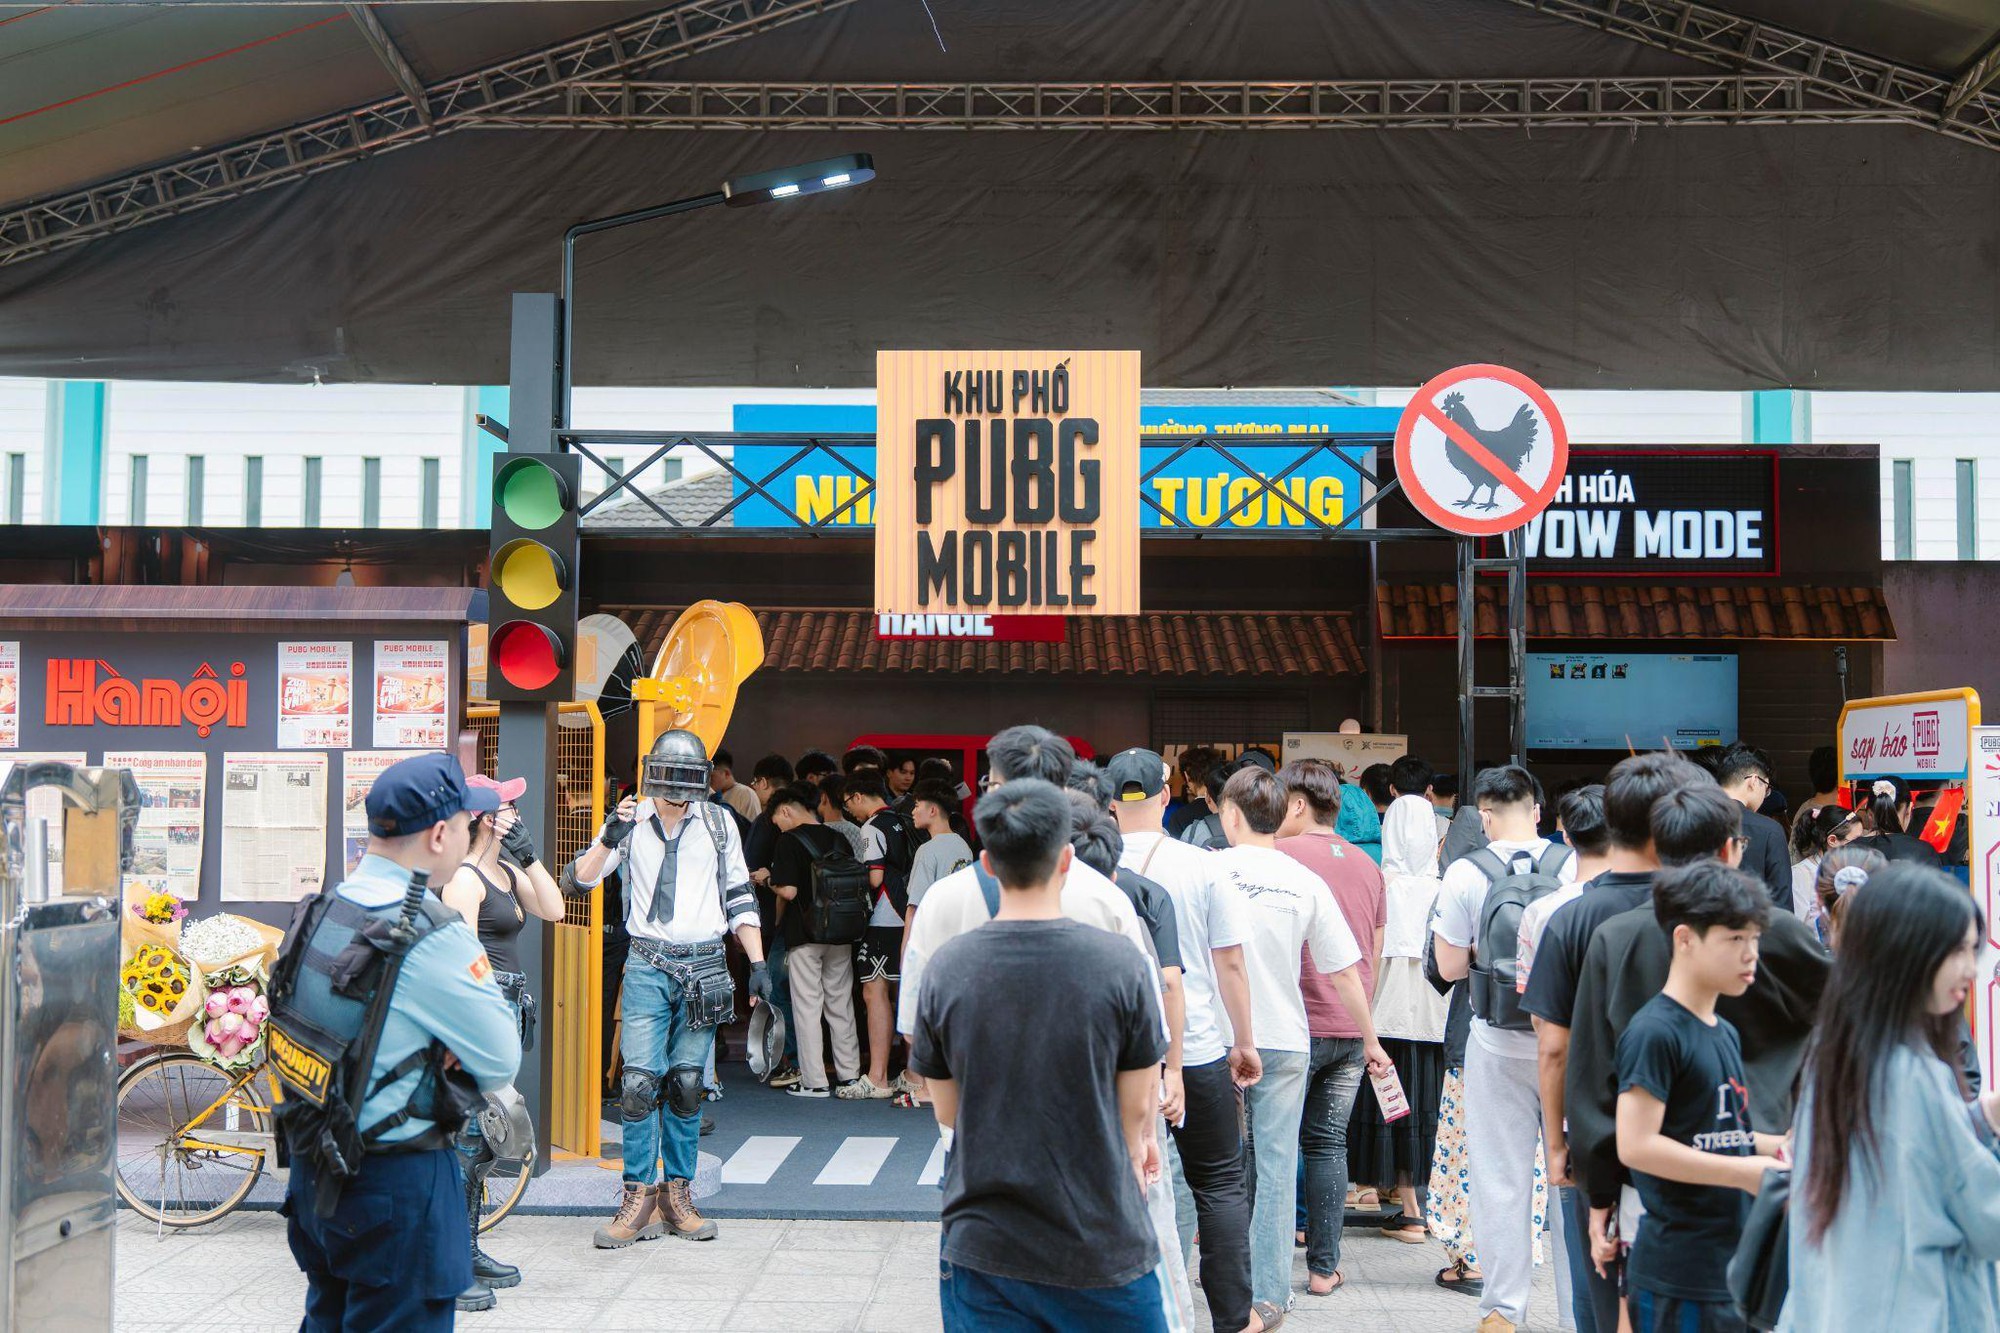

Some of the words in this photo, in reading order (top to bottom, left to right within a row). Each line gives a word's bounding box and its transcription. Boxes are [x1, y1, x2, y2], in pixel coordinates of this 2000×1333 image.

[944, 370, 1003, 414] KHU
[1012, 357, 1070, 414] PHỐ
[914, 417, 1100, 524] PUBG
[1578, 469, 1636, 503] HÓA
[795, 474, 876, 525] NH
[1152, 472, 1345, 527] TƯƠNG
[1633, 510, 1763, 559] MODE
[917, 530, 1097, 606] MOBILE
[1879, 721, 1908, 758] báo
[1916, 719, 1937, 748] PUBG
[1916, 758, 1937, 769] MOBILE
